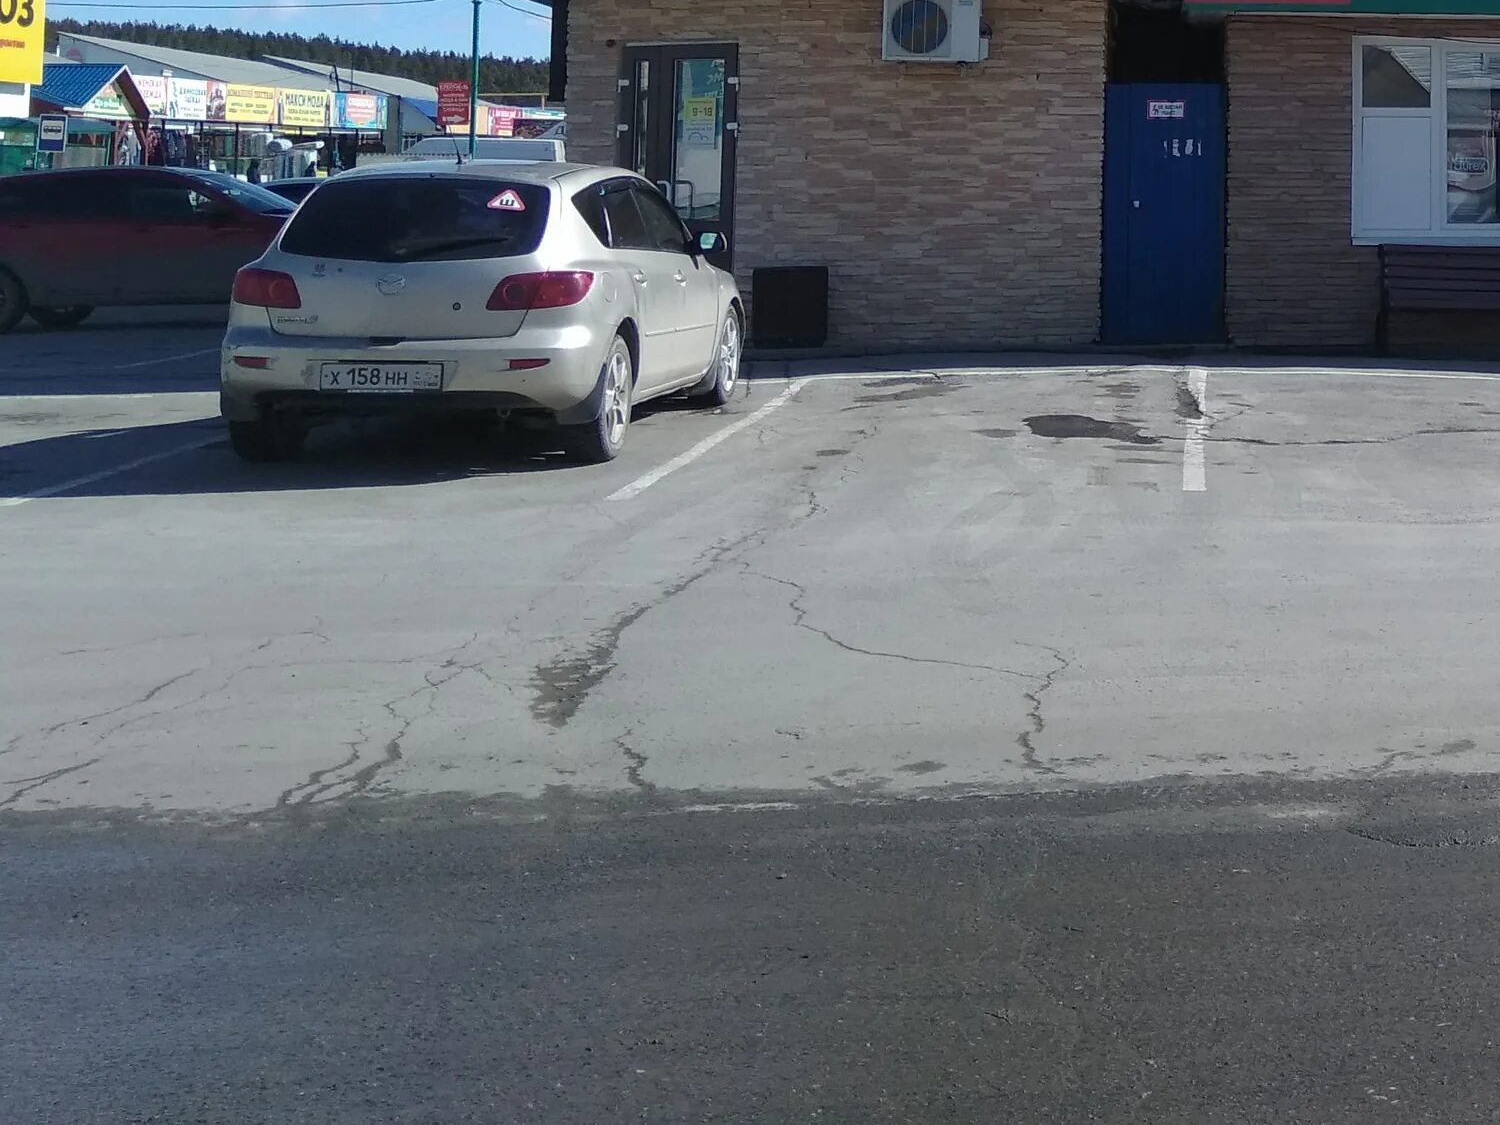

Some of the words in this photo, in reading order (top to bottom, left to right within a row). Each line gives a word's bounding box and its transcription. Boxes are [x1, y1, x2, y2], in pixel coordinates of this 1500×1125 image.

[285, 93, 306, 107] МАКСИ
[307, 94, 324, 108] МОДА
[500, 199, 515, 207] Ш
[346, 368, 381, 386] 158
[385, 371, 408, 386] НН
